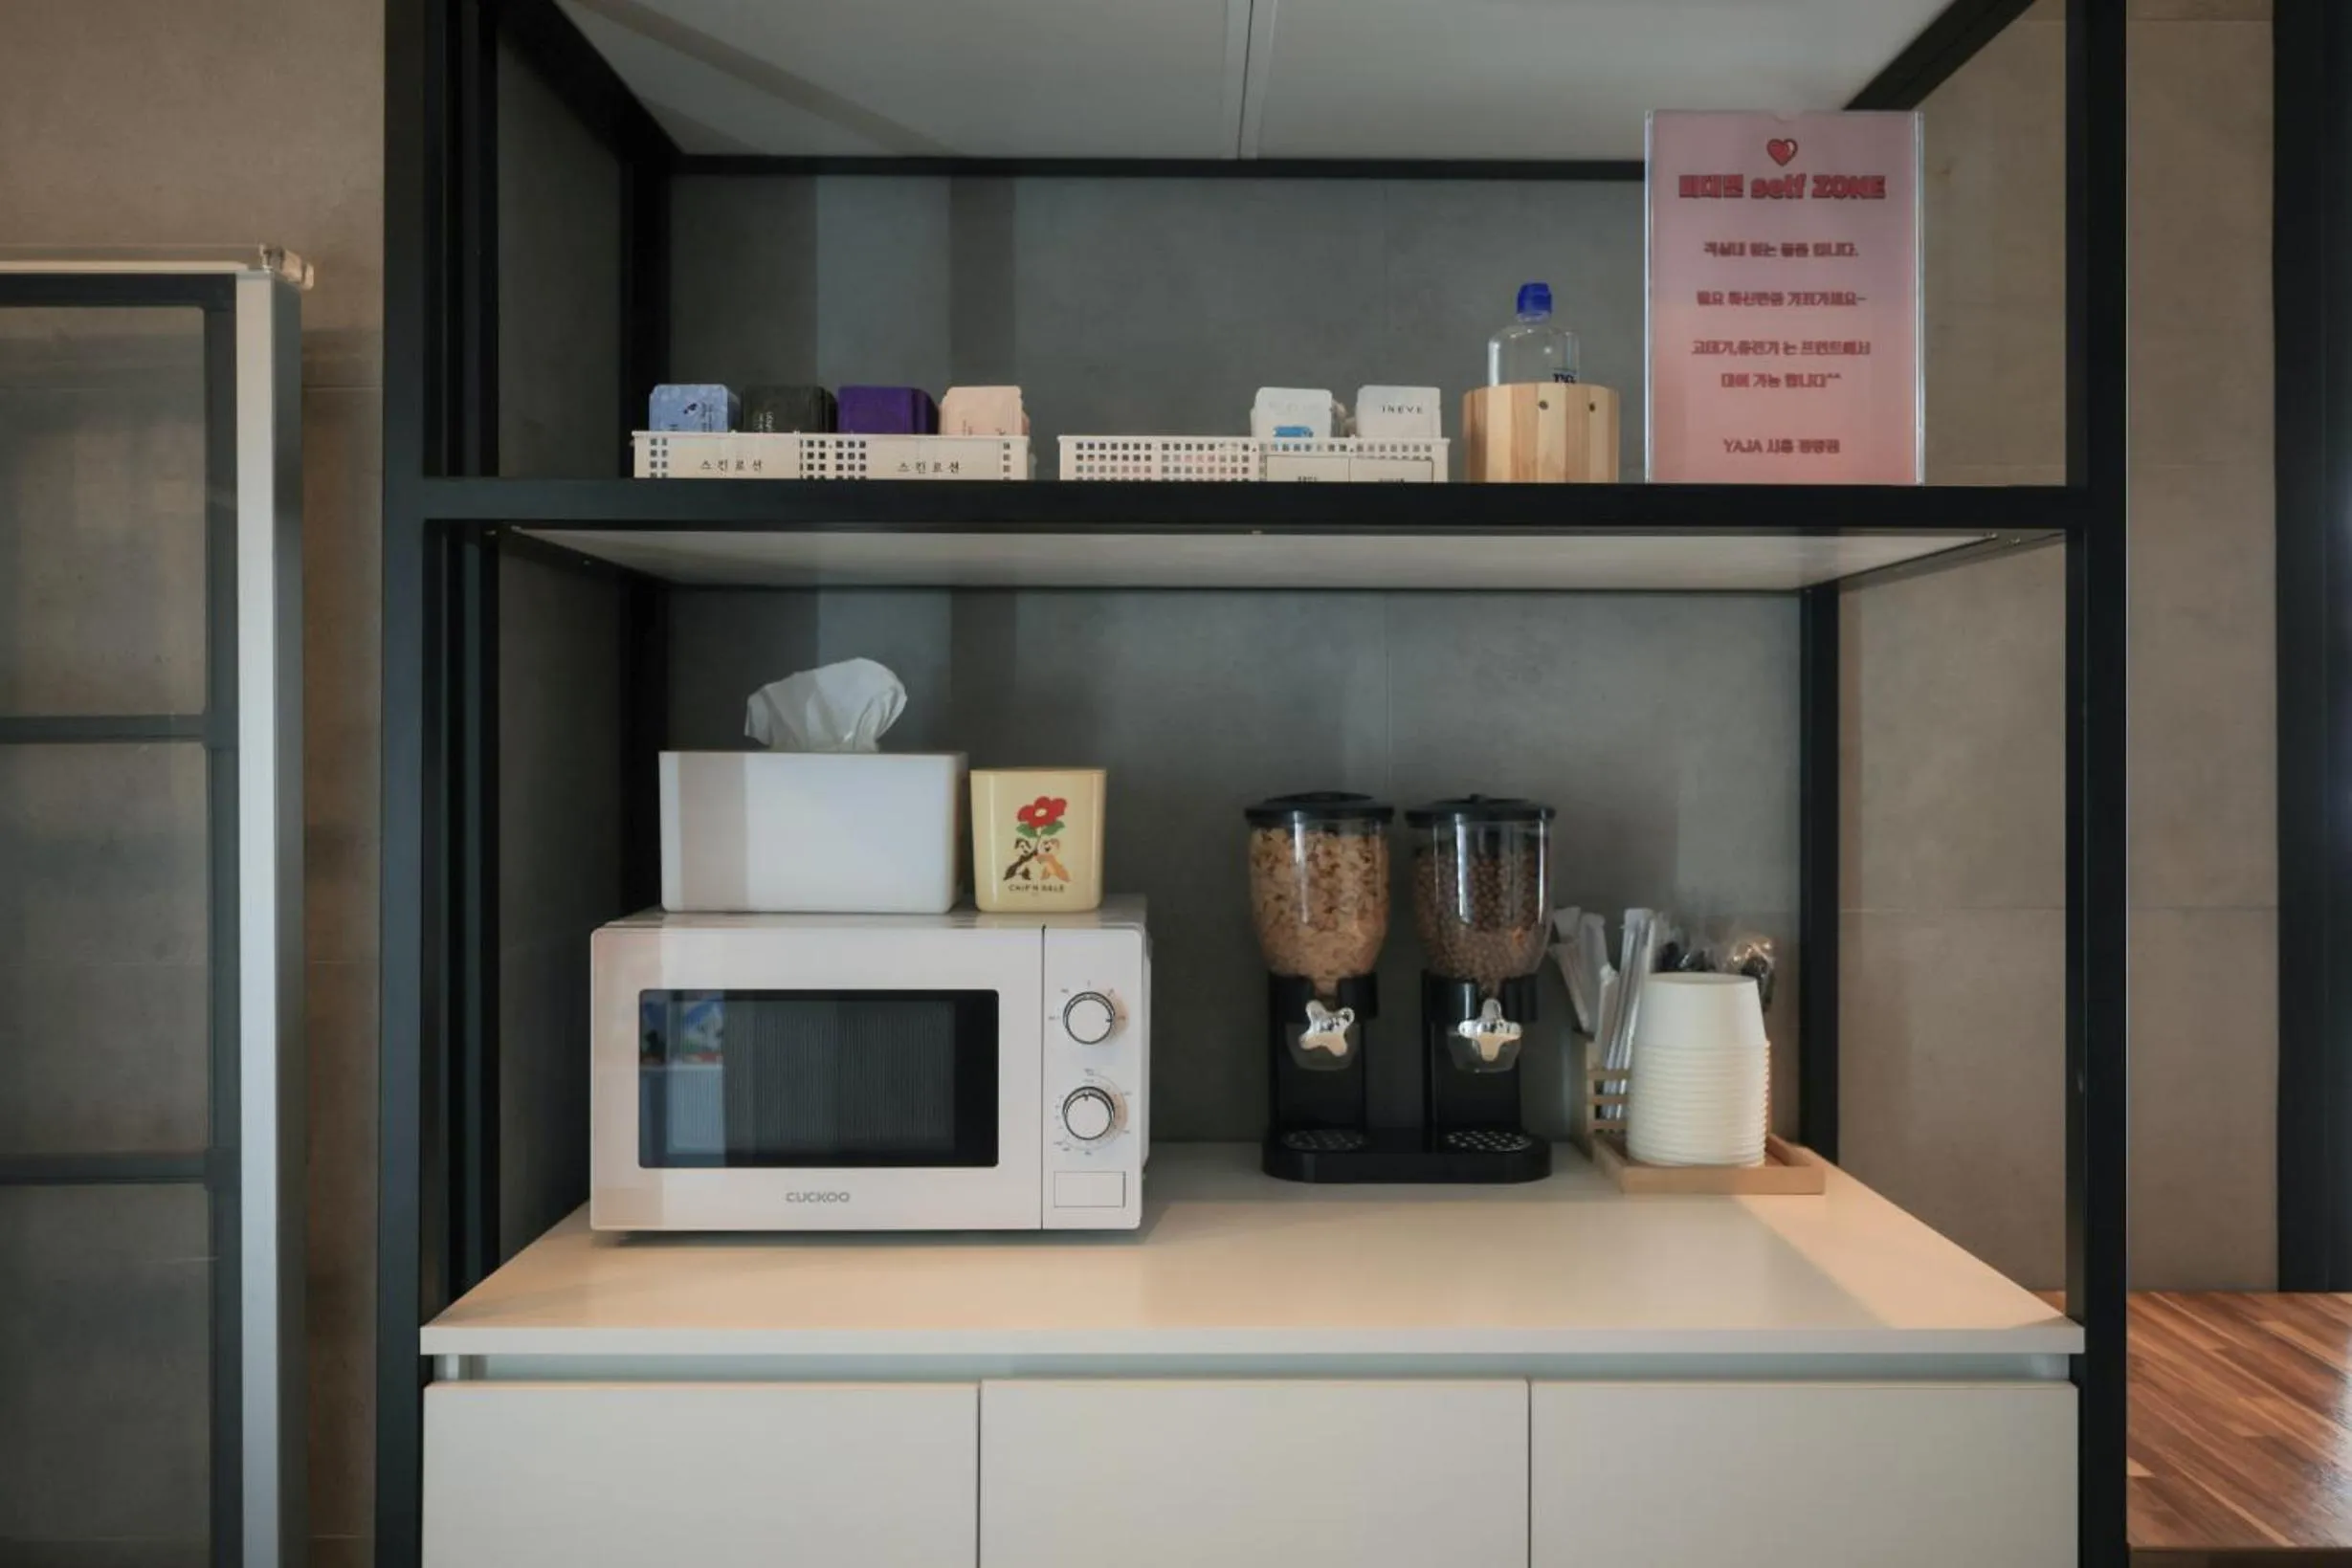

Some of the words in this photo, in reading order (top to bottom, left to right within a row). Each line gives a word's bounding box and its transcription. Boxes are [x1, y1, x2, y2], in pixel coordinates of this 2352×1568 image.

[1811, 174, 1886, 199] ZONE
[1753, 372, 1782, 387] 가능
[1723, 438, 1764, 453] YAJA
[786, 1191, 851, 1204] CUCKOO
